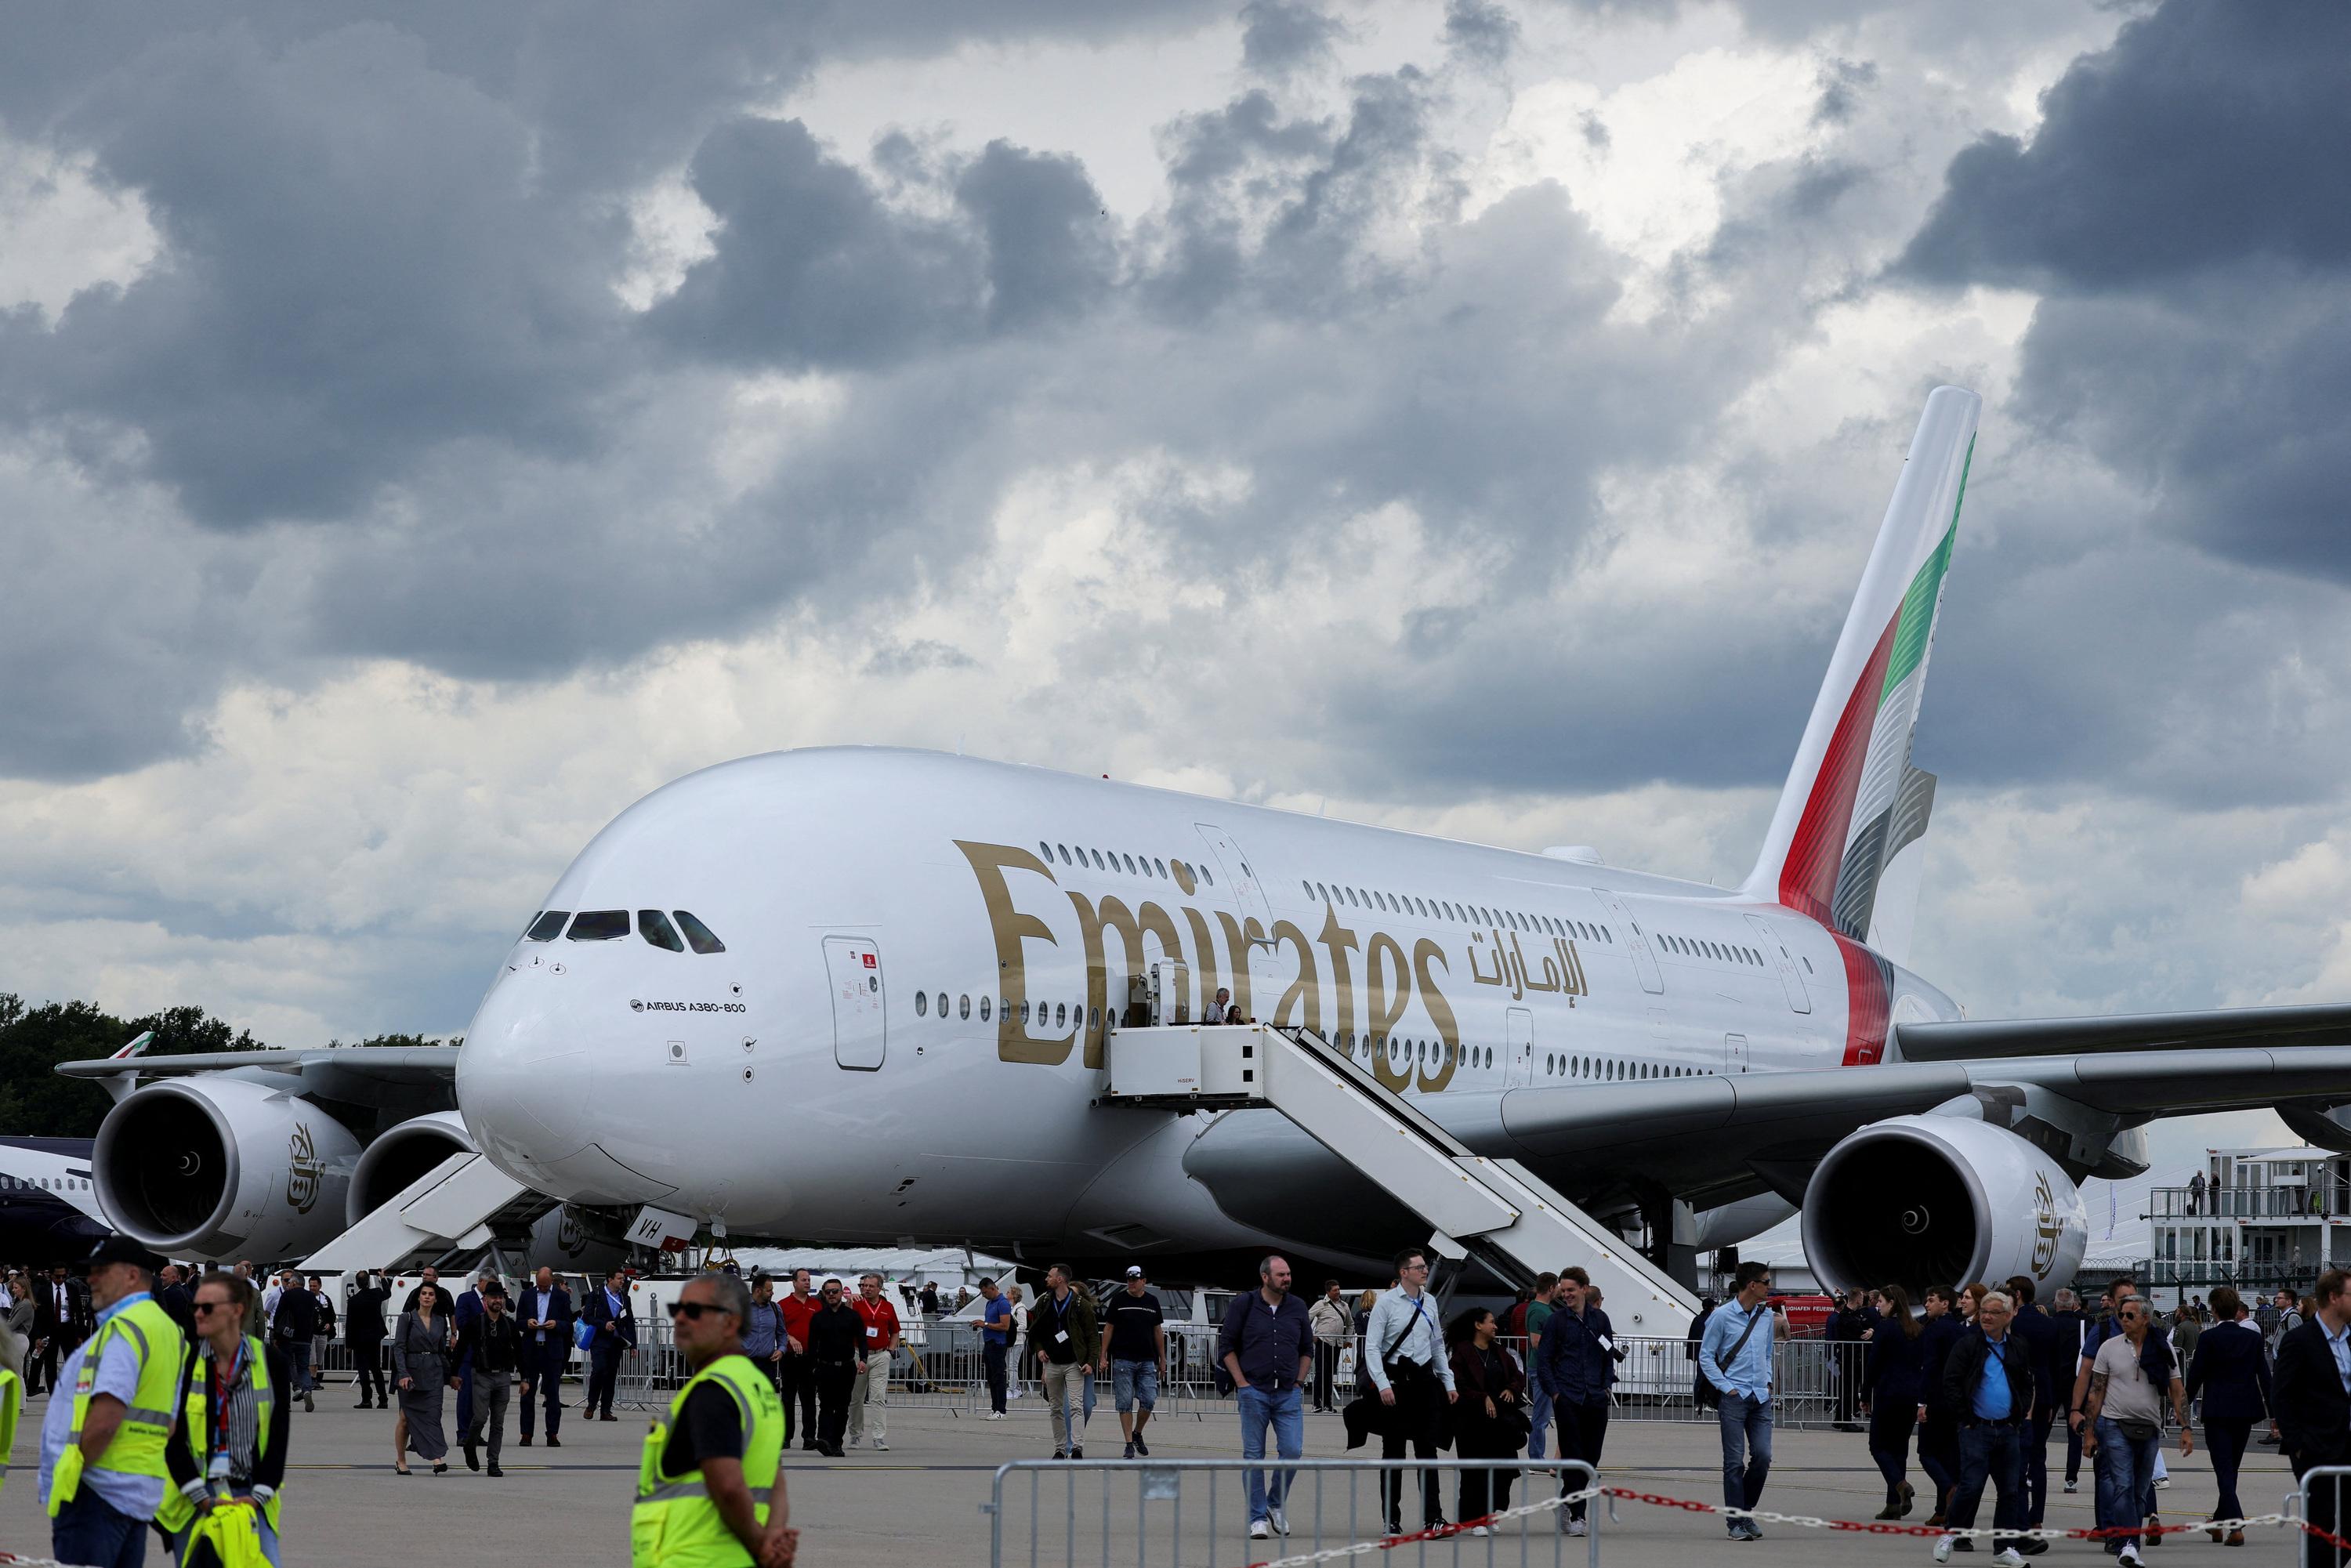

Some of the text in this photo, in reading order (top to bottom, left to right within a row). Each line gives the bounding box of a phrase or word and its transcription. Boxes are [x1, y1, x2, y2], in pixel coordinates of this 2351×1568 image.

[951, 840, 1459, 1093] Emirates
[1468, 929, 1588, 1009] الإمارات
[647, 1001, 746, 1013] AIRBUS A380-800
[638, 1219, 662, 1239] VH
